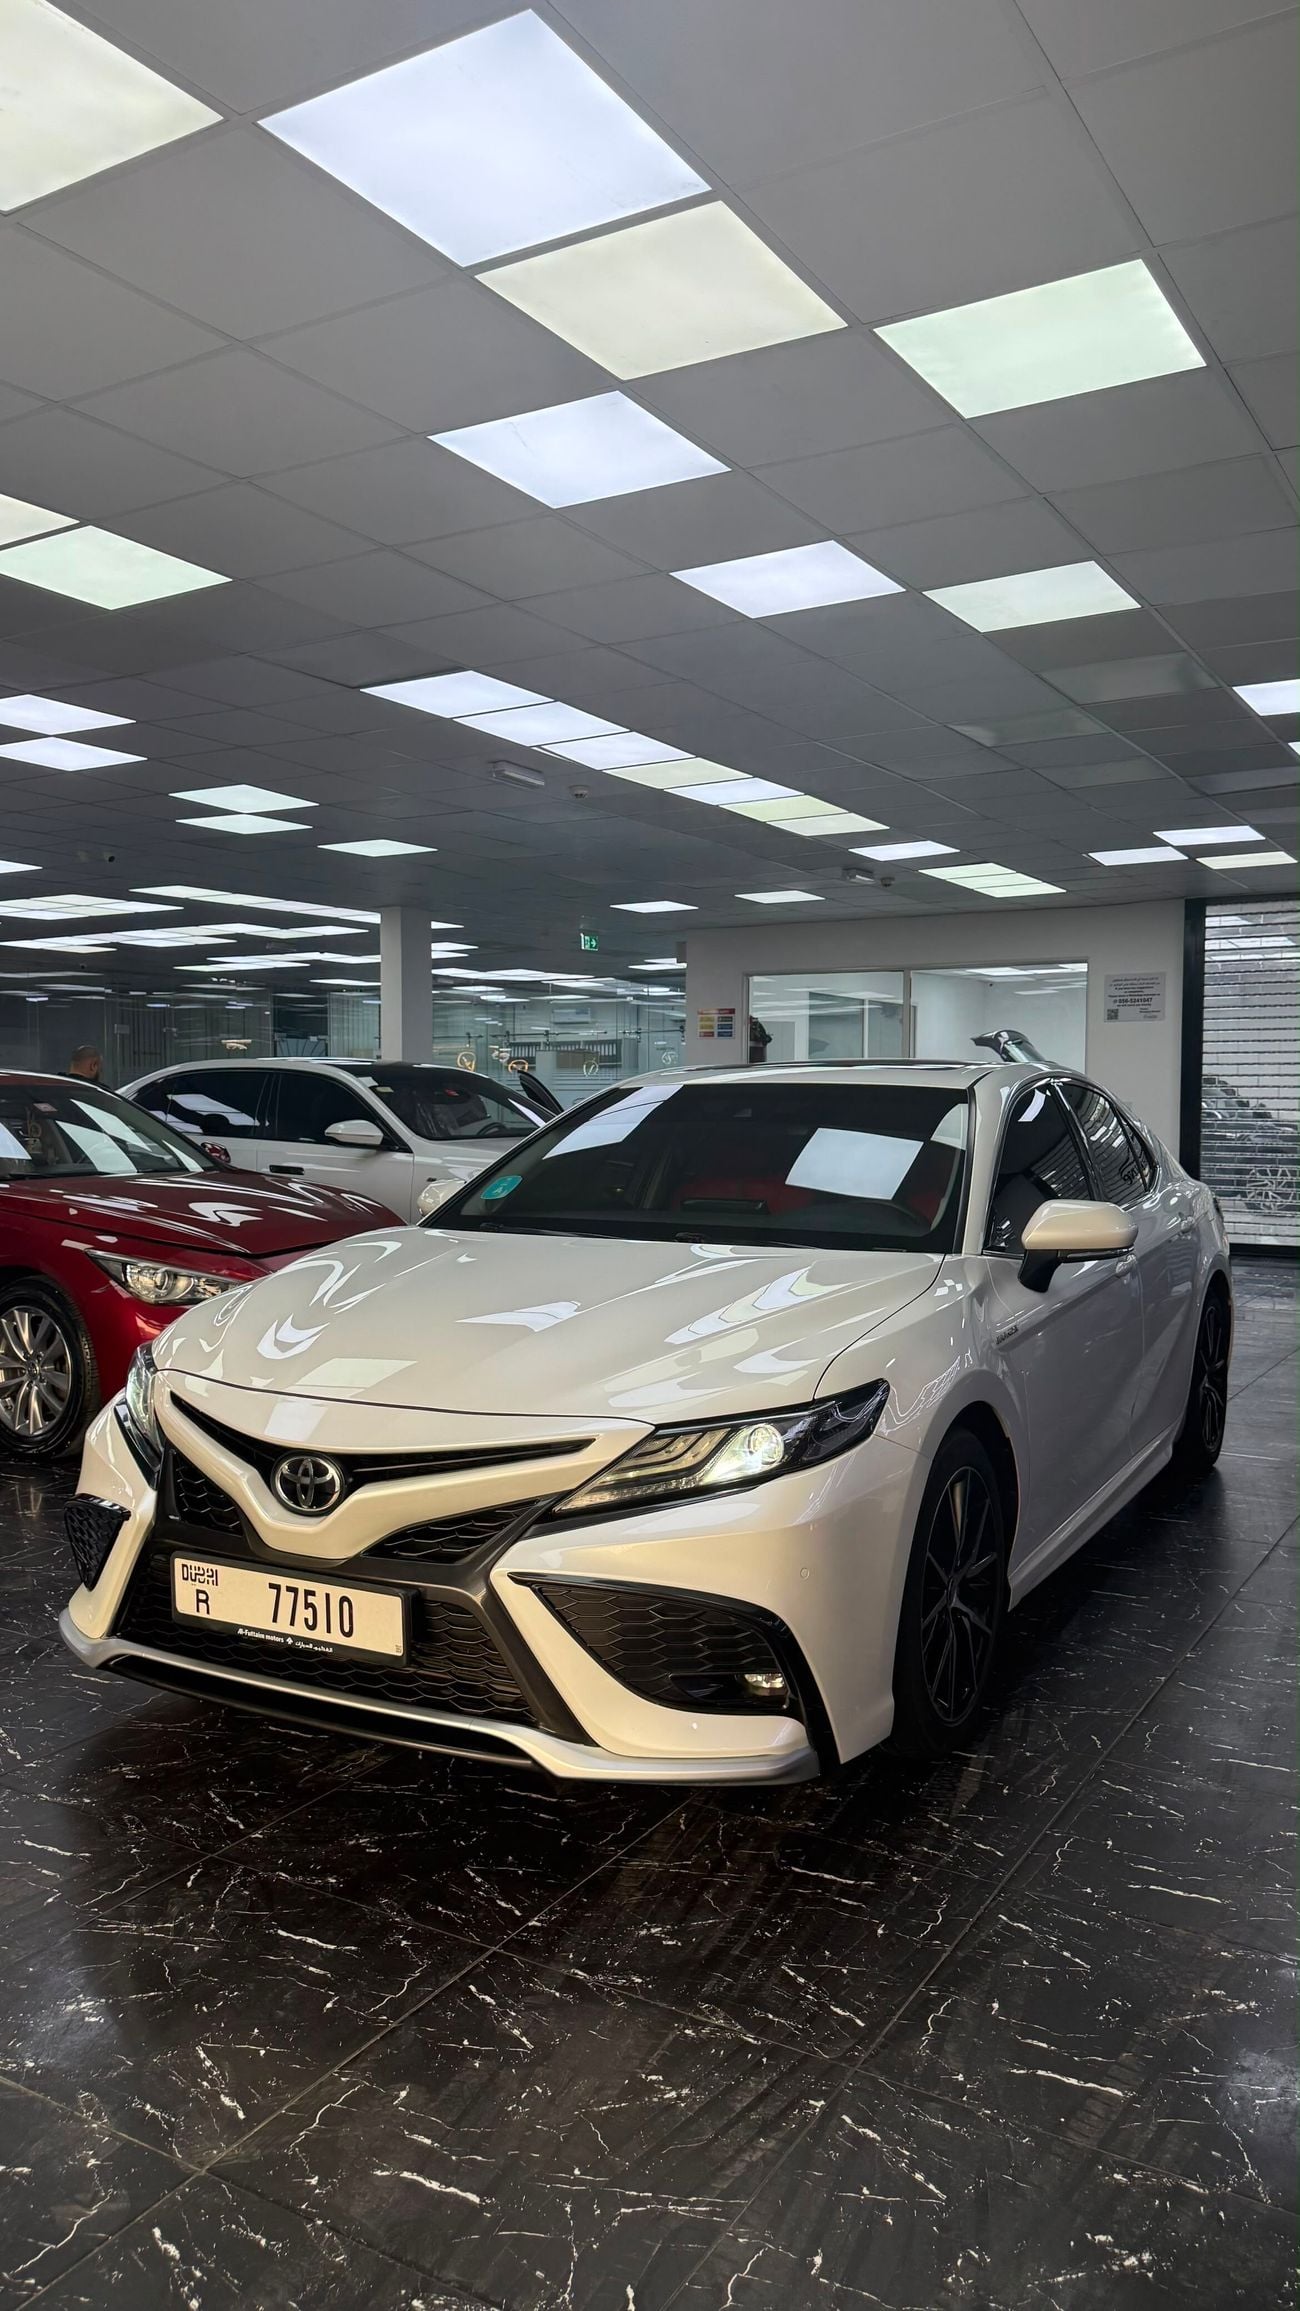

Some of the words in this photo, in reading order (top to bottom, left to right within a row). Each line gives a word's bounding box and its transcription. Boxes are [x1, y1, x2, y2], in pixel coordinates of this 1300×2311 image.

[195, 1588, 211, 1615] R
[268, 1582, 355, 1639] 77510
[265, 1634, 285, 1643] motors
